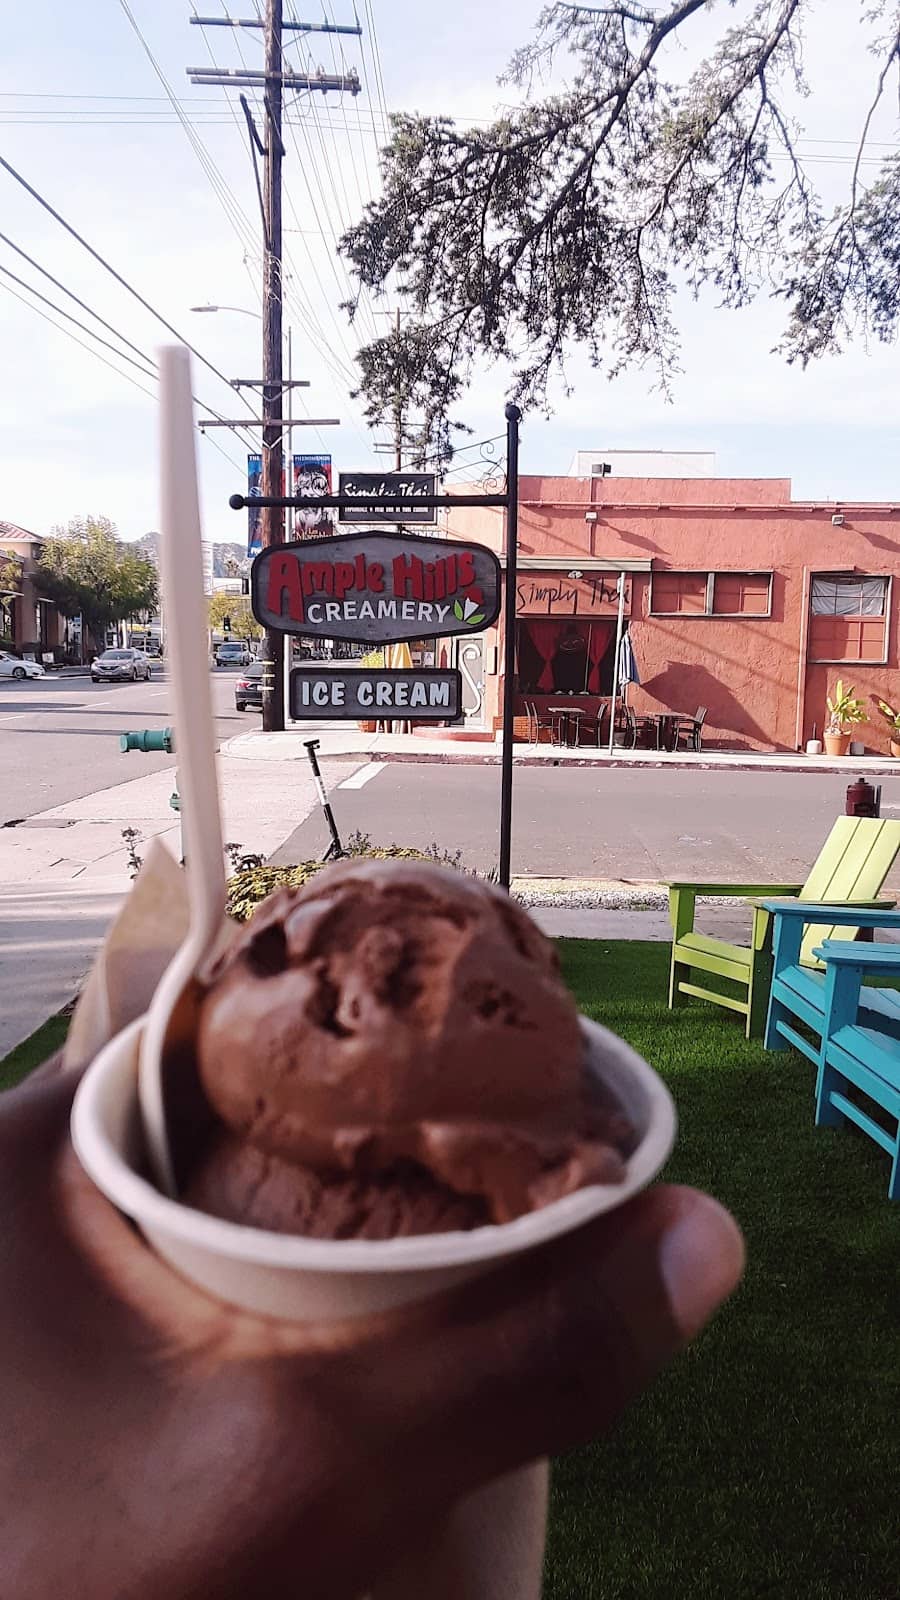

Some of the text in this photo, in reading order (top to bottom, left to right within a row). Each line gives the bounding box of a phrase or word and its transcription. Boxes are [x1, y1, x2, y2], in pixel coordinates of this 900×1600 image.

[267, 551, 477, 624] Ample Hills
[517, 577, 630, 615] Simply Thai
[307, 599, 451, 624] CREAMERY
[301, 681, 450, 707] ICE CREAM
